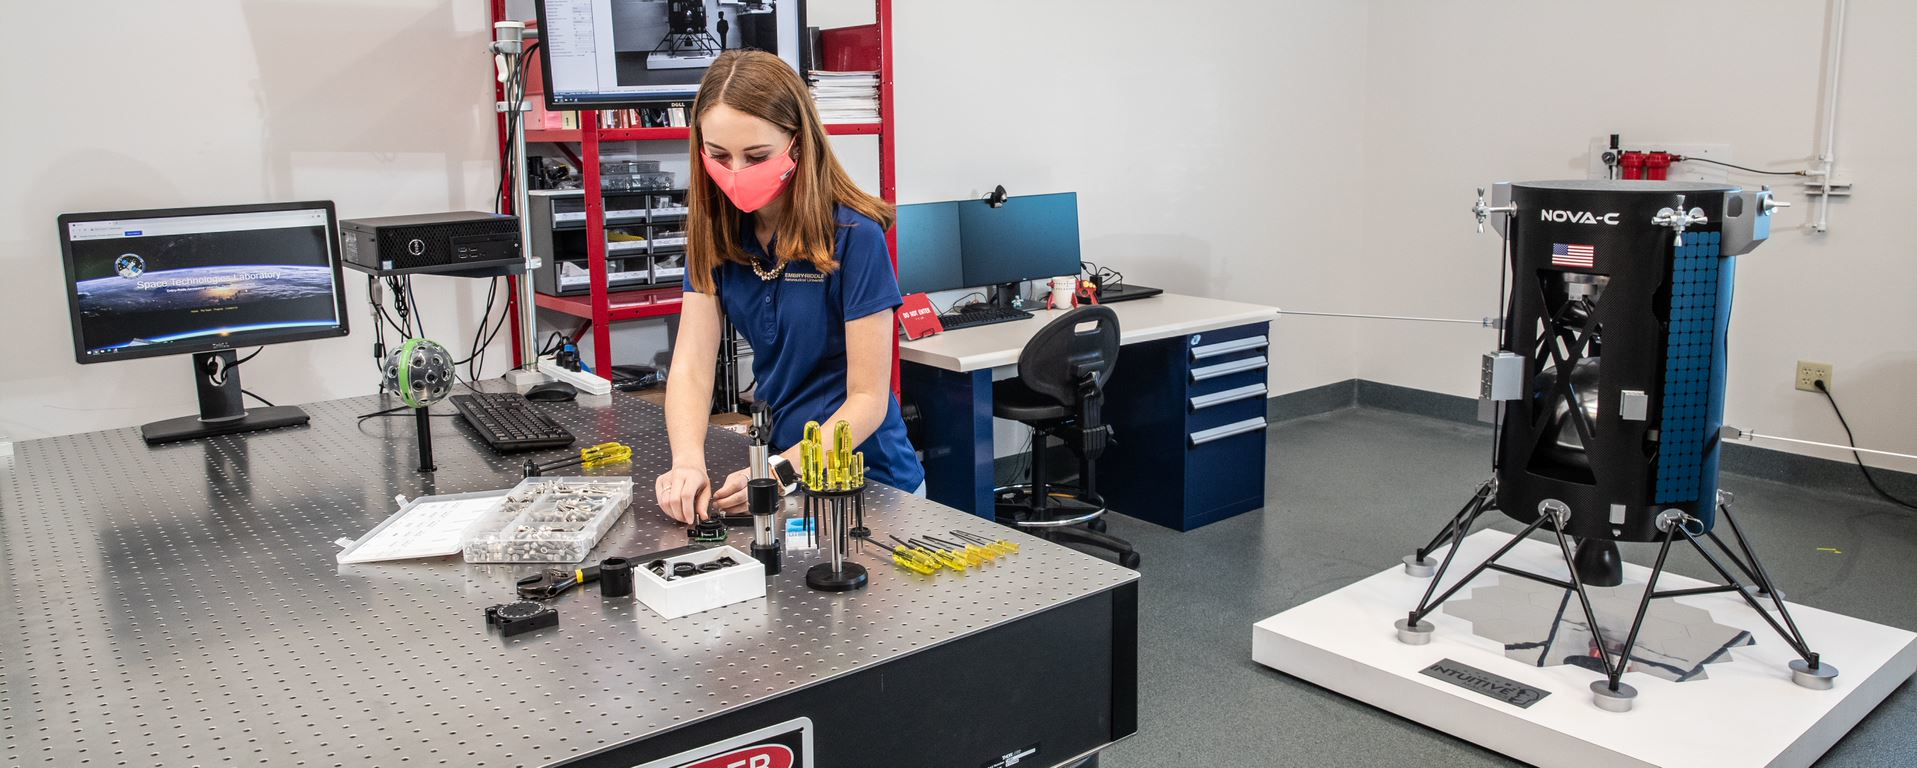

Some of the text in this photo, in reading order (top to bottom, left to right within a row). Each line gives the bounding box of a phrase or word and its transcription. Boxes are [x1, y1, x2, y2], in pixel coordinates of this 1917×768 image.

[1541, 209, 1620, 225] NOVA-C
[137, 271, 281, 290] Space Technologies Laboratory
[917, 307, 931, 316] ENTER
[1430, 664, 1518, 695] INTUITIVE
